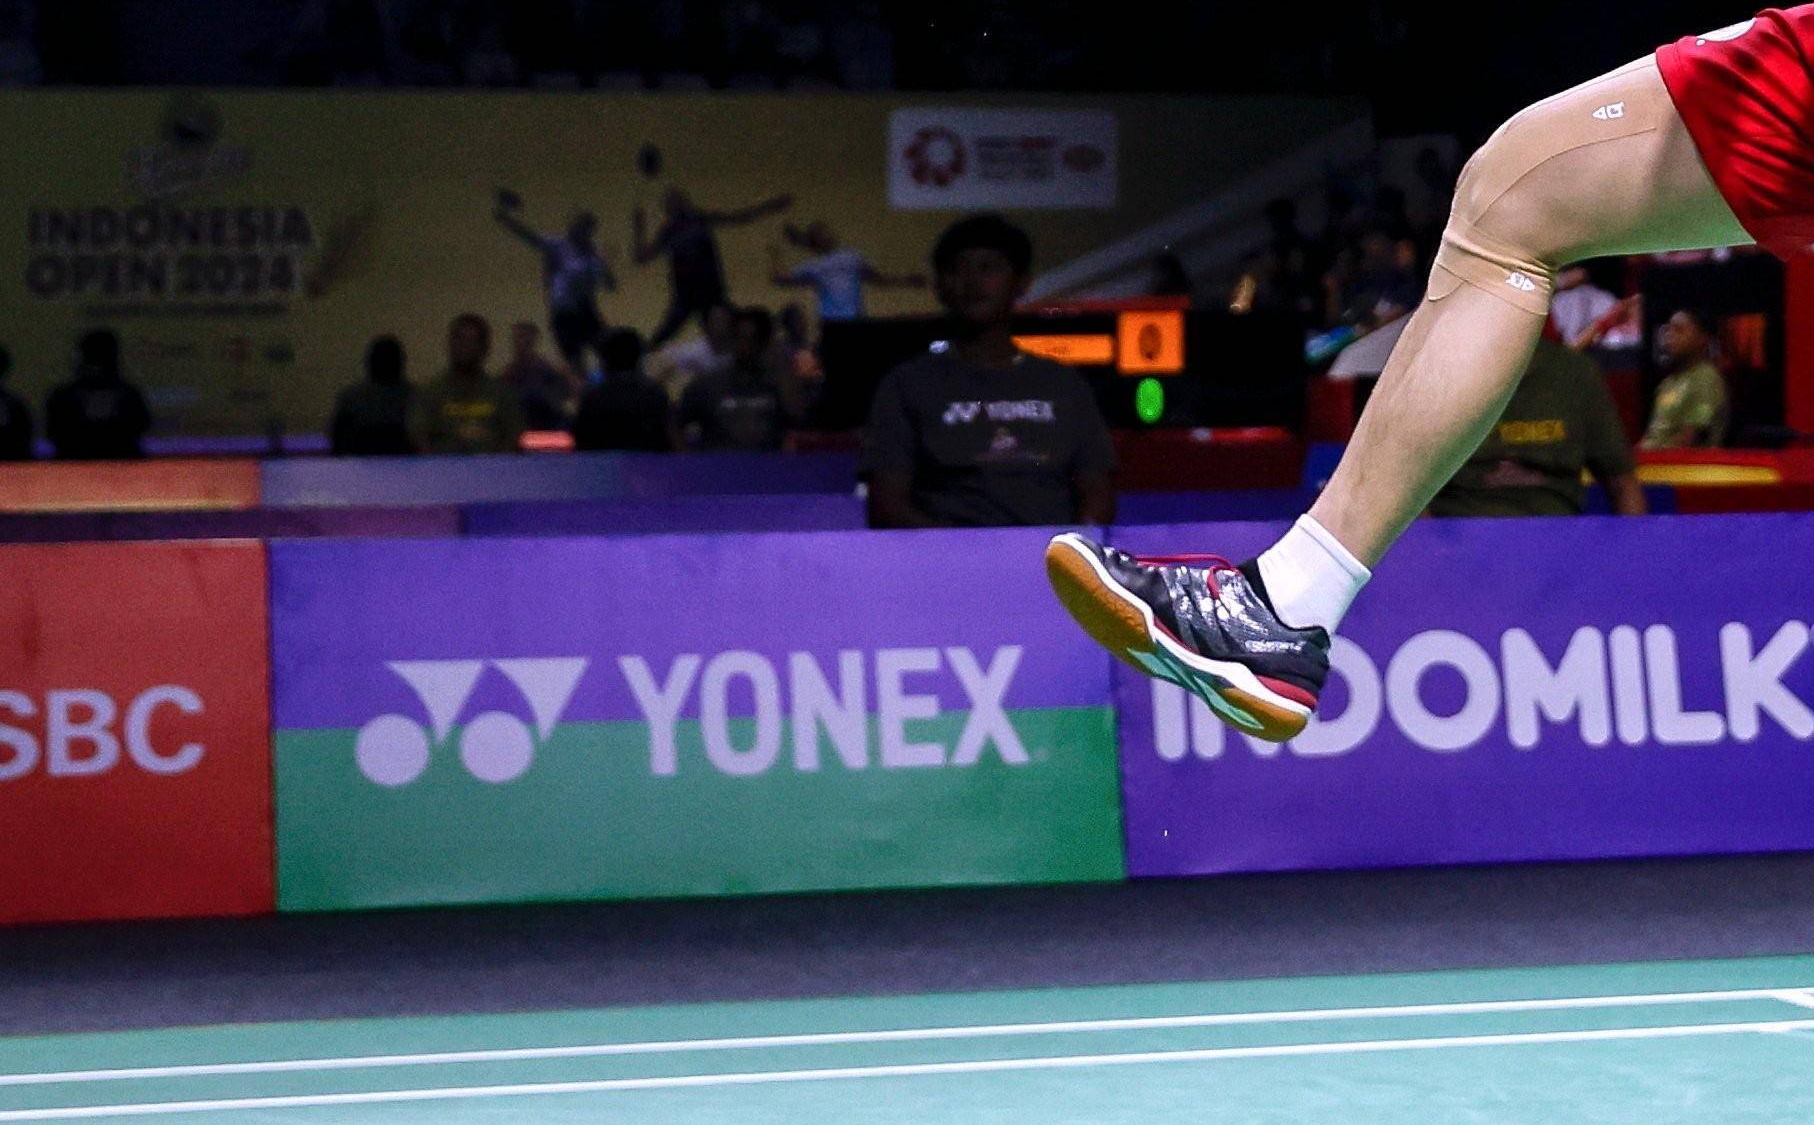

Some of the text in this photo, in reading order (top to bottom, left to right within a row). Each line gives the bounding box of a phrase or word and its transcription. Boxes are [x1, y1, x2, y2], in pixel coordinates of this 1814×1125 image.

[27, 206, 320, 249] INDONESIA
[26, 254, 166, 299] OPEN
[617, 644, 1030, 777] YONEX
